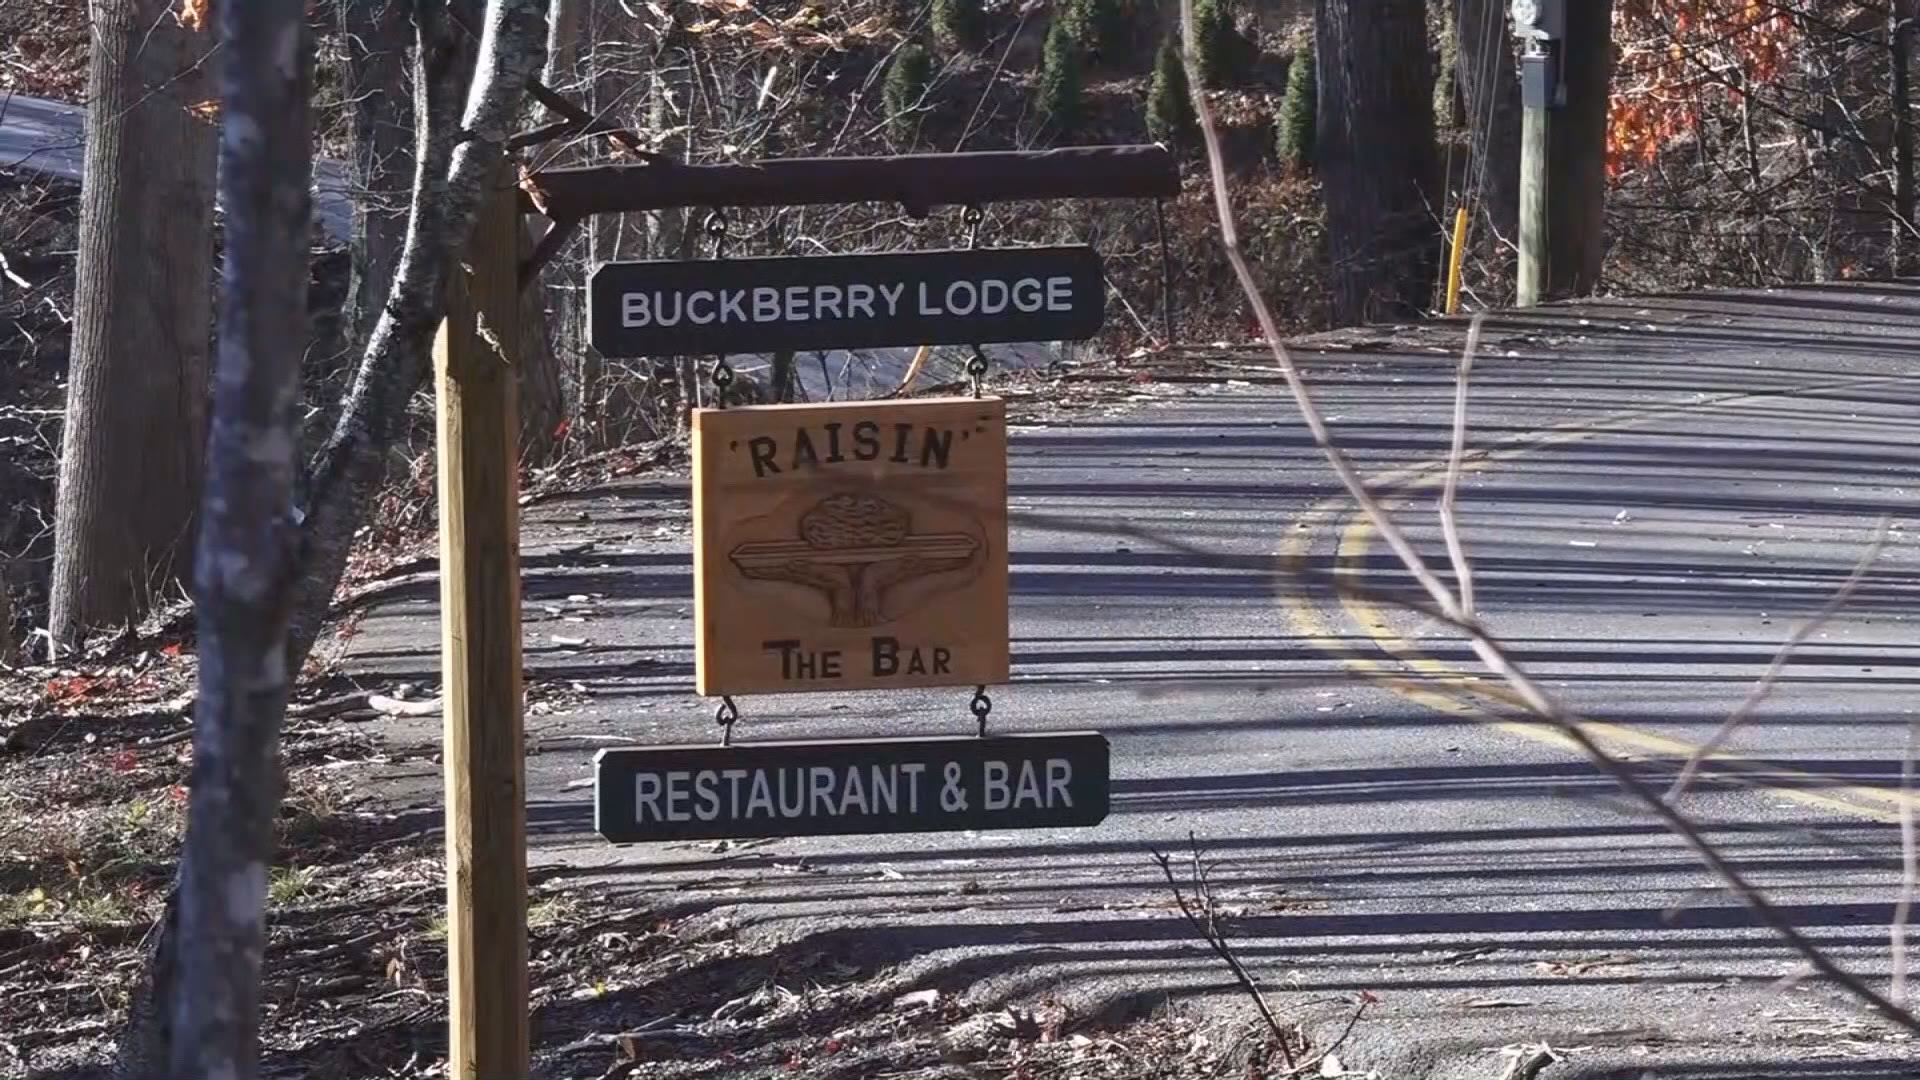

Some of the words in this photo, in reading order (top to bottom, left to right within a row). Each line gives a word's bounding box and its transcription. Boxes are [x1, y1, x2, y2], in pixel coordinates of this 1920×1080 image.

[621, 283, 904, 328] BUCKBERRY
[918, 276, 1073, 315] LODGE
[635, 762, 925, 823] RESTAURANT
[939, 761, 969, 812] &
[984, 758, 1073, 810] BAR
